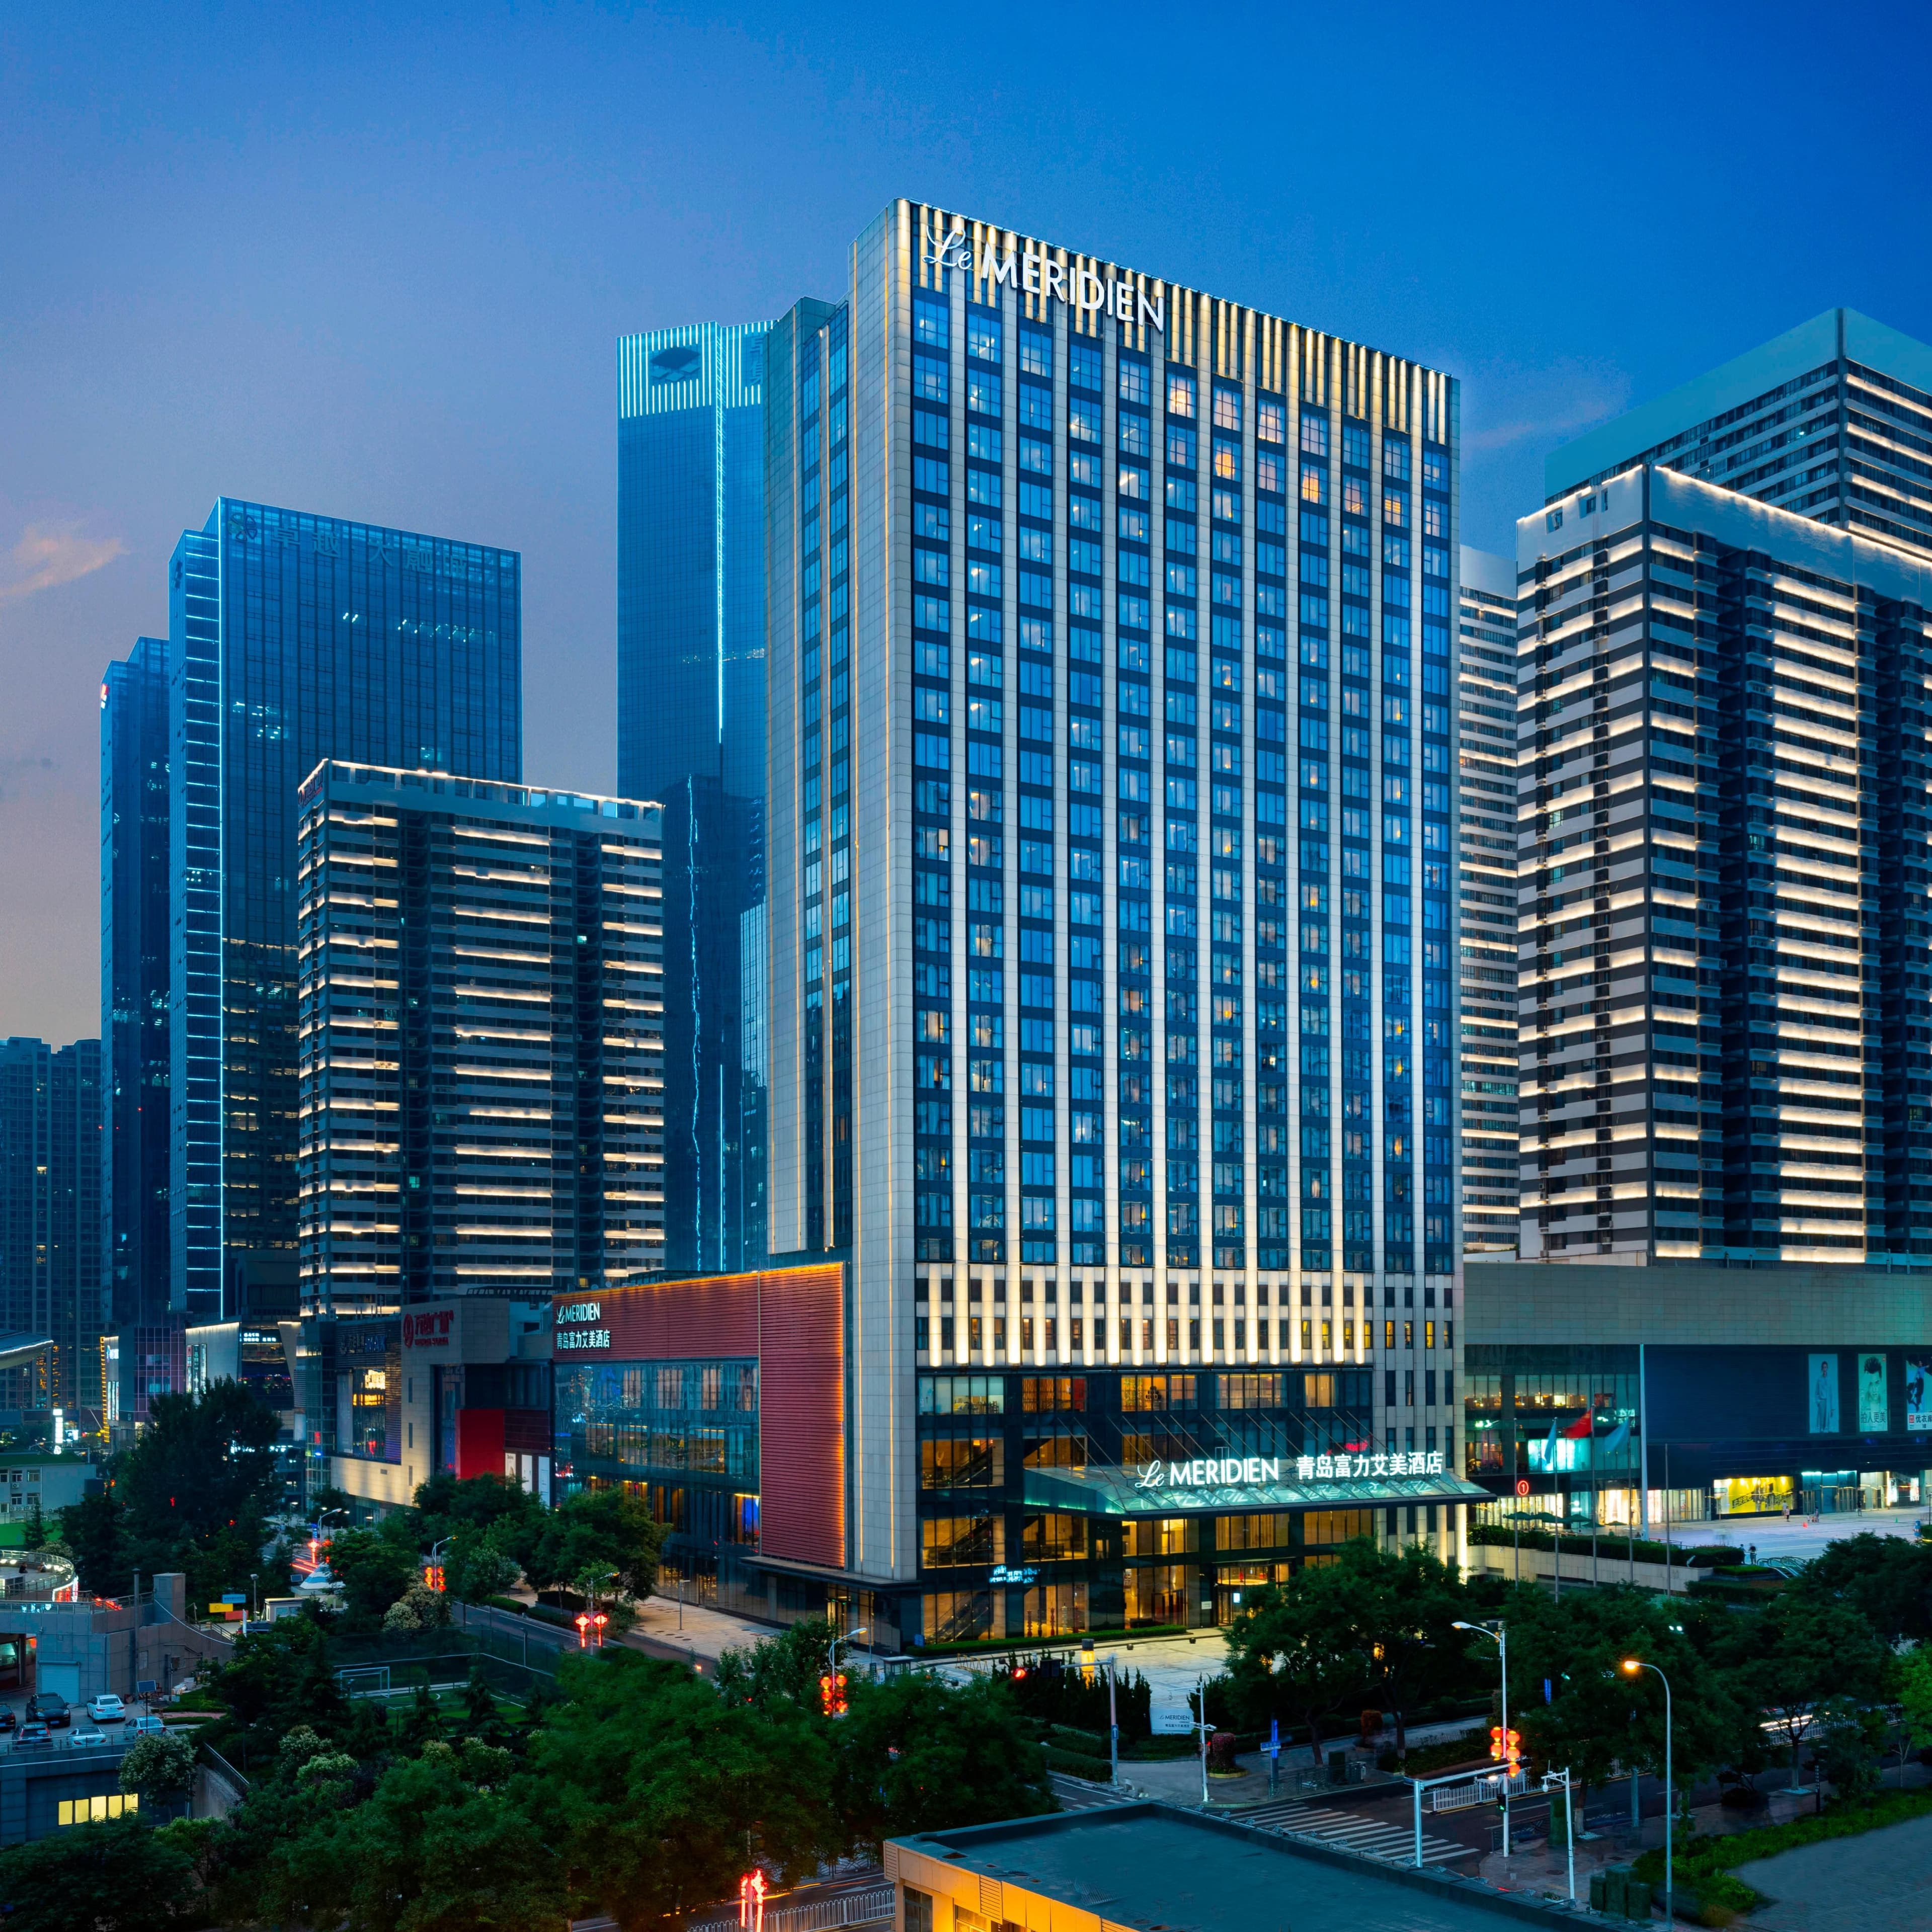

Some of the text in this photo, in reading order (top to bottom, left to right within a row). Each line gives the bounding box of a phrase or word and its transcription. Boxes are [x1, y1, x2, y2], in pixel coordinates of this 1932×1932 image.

[922, 225, 1164, 334] Le MERIDIEN
[555, 1302, 600, 1324] Le MERIDIEN
[556, 1329, 610, 1350] 青岛富力艾美酒店
[1135, 1458, 1279, 1488] Le MERIDIEN
[1296, 1451, 1443, 1480] 青岛富力艾美酒店
